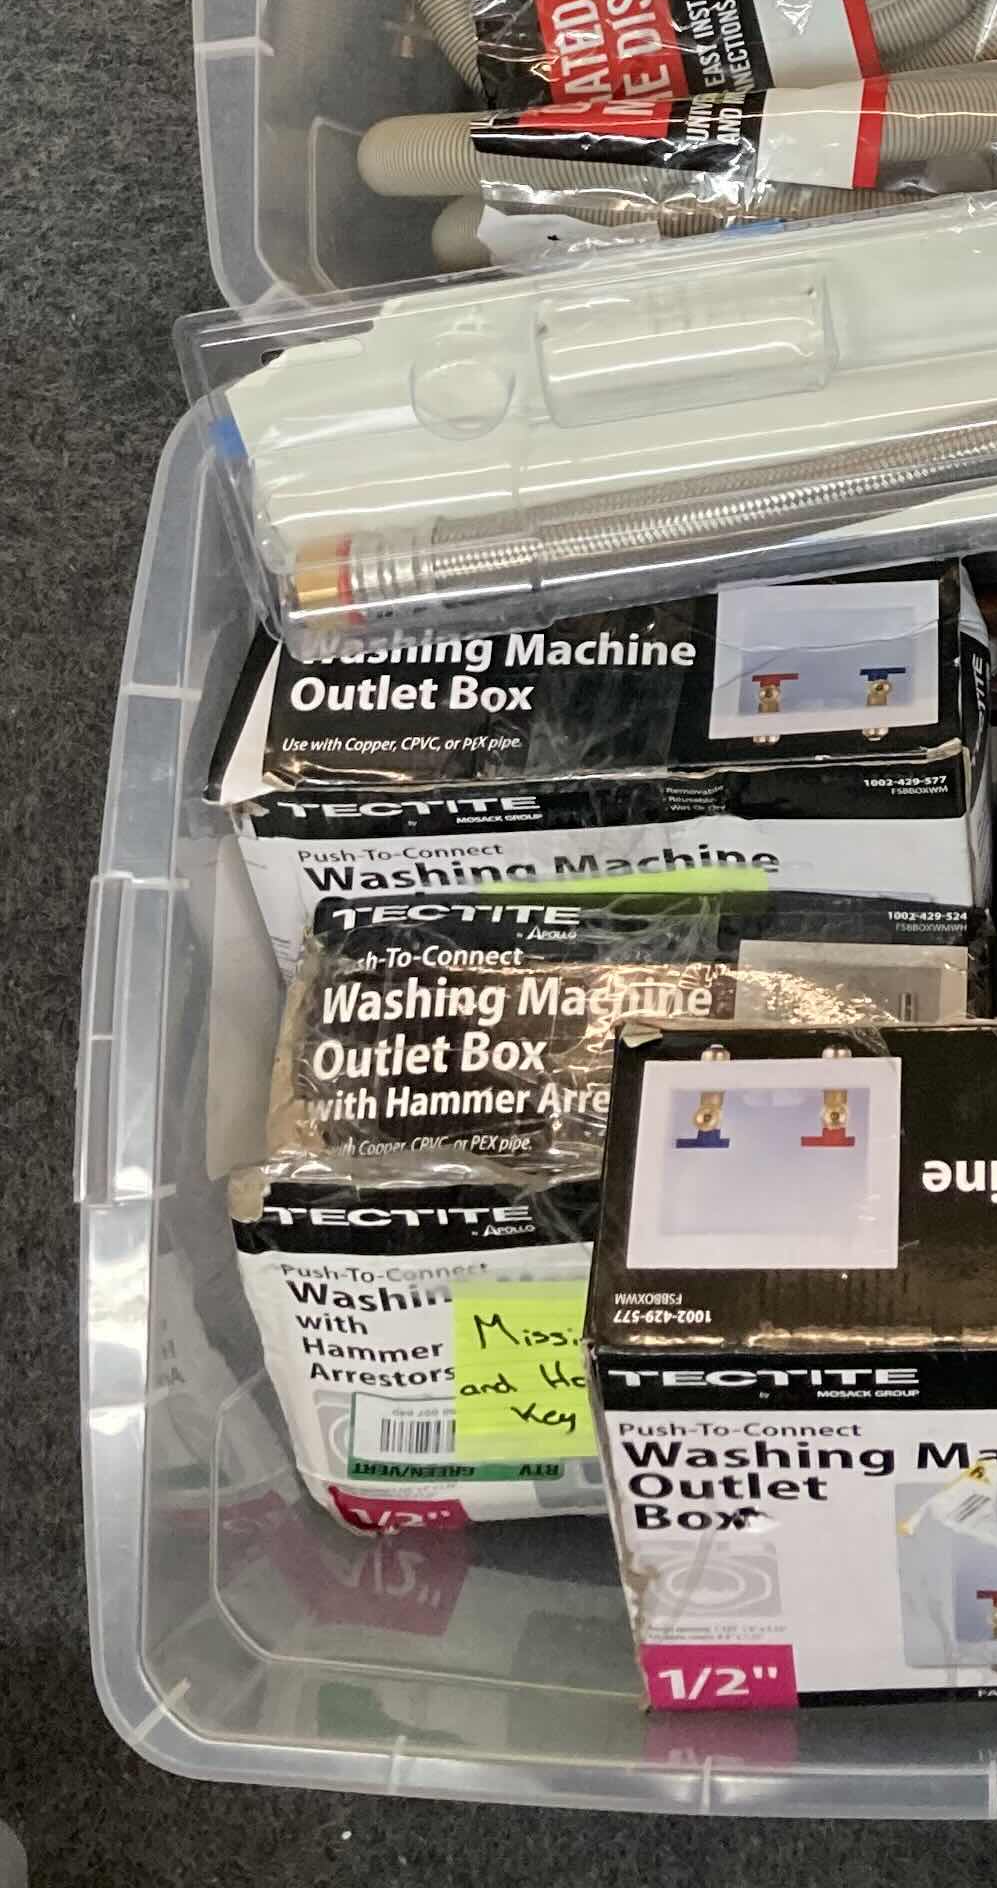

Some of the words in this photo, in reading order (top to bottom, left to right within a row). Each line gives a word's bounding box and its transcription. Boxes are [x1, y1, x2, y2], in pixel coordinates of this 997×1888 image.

[699, 46, 726, 88] EASY
[505, 631, 697, 668] Machine
[290, 674, 439, 712] Outlet
[449, 675, 535, 712] Box
[282, 737, 308, 752] Use
[310, 736, 343, 752] with
[345, 736, 398, 754] Copper,
[400, 736, 441, 753] CPVC,
[444, 739, 461, 751] or
[462, 737, 487, 751] PEX
[864, 775, 947, 787] 1002-429-577
[277, 796, 541, 819] TECTITE
[456, 815, 502, 824] MOSACK
[504, 812, 544, 822] GROUP
[298, 844, 504, 864] Push-To-Connect
[303, 863, 537, 892] Washing
[332, 905, 582, 931] TECTITE
[888, 911, 968, 922] 1002-429-524
[322, 976, 507, 1027] Washing
[517, 975, 713, 1018] Machine
[312, 1032, 451, 1082] Outlet
[460, 1031, 548, 1074] Box
[310, 1085, 378, 1123] with
[386, 1086, 530, 1121] Hammer
[470, 1134, 499, 1152] PEX
[499, 1135, 533, 1152] pipe.
[262, 1204, 533, 1227] TECTITE
[280, 1262, 489, 1284] Push-To-Connect
[296, 1312, 369, 1336] with
[613, 1310, 713, 1325] 1002-429-577
[302, 1337, 443, 1359] Hammer
[309, 1362, 457, 1387] Arrestors
[459, 1373, 519, 1397] and
[607, 1367, 920, 1388] TECTITE
[816, 1389, 871, 1399] MOSACK
[873, 1388, 920, 1398] GROUP
[510, 1402, 577, 1435] Key
[619, 1422, 862, 1440] Push-To-Connect
[518, 1462, 561, 1477] RTV
[622, 1440, 896, 1476] Washing
[351, 1462, 476, 1479] GREEN/VERT
[628, 1473, 829, 1501] Outlet
[657, 1665, 780, 1700] 1/2"
